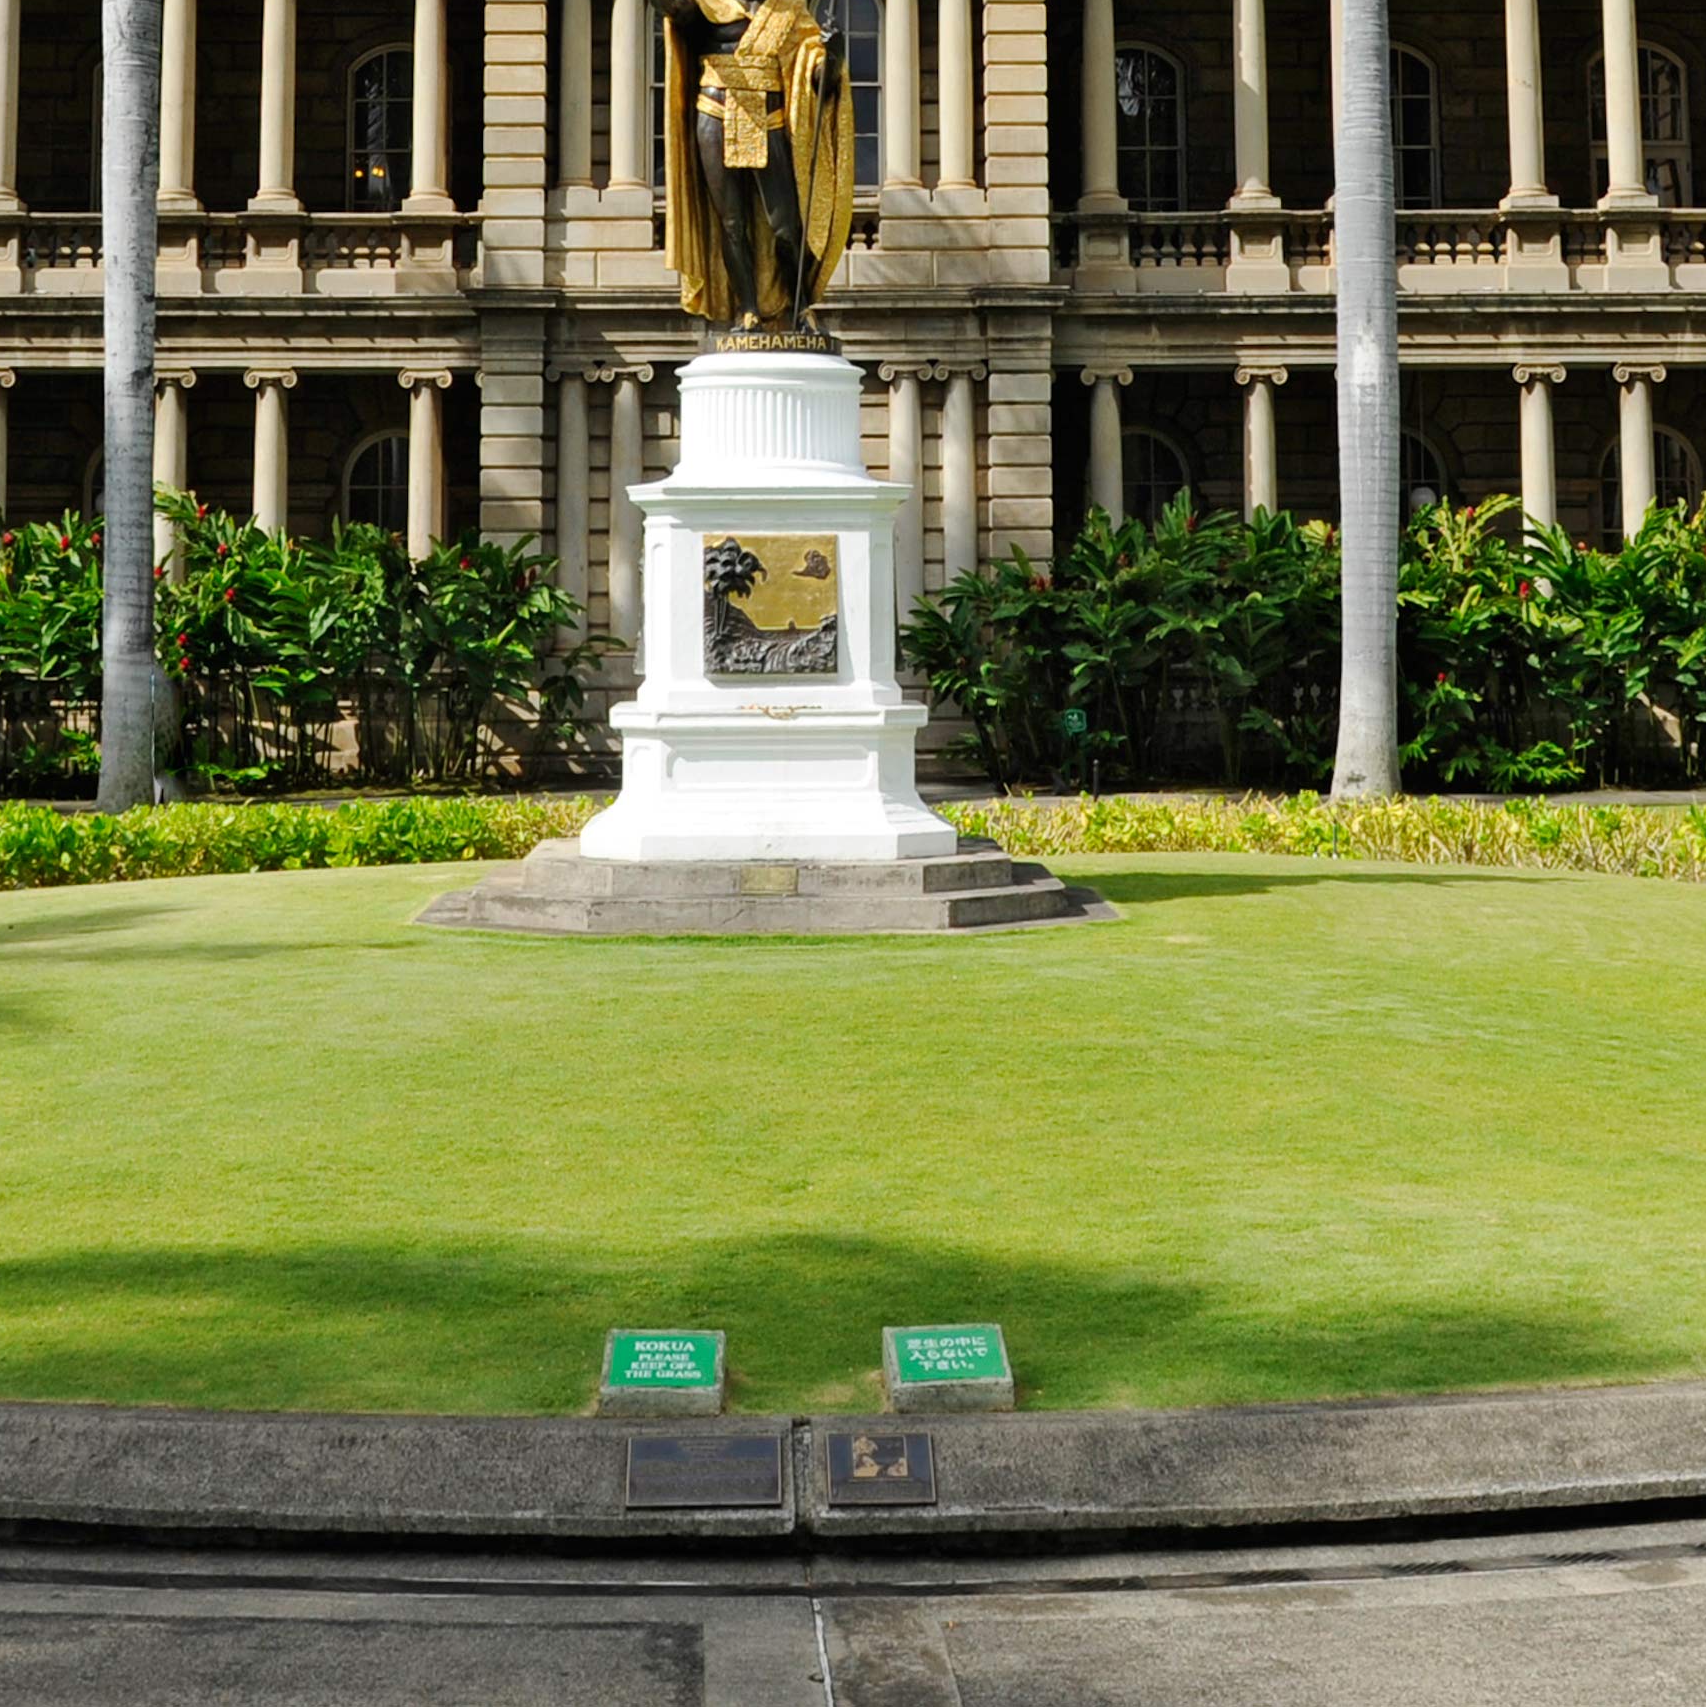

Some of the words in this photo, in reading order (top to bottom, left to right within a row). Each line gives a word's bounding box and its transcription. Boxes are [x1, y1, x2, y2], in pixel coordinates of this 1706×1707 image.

[716, 335, 826, 351] KAMEHAMEHA
[634, 1340, 695, 1352] KOKUA
[639, 1353, 690, 1362] PLEASE
[909, 1347, 988, 1361] 入らないで
[631, 1362, 666, 1370] KEEP
[670, 1362, 696, 1370] OFF
[917, 1359, 975, 1371] 下さい。
[625, 1370, 652, 1379] THE
[656, 1370, 702, 1379] GRASS
